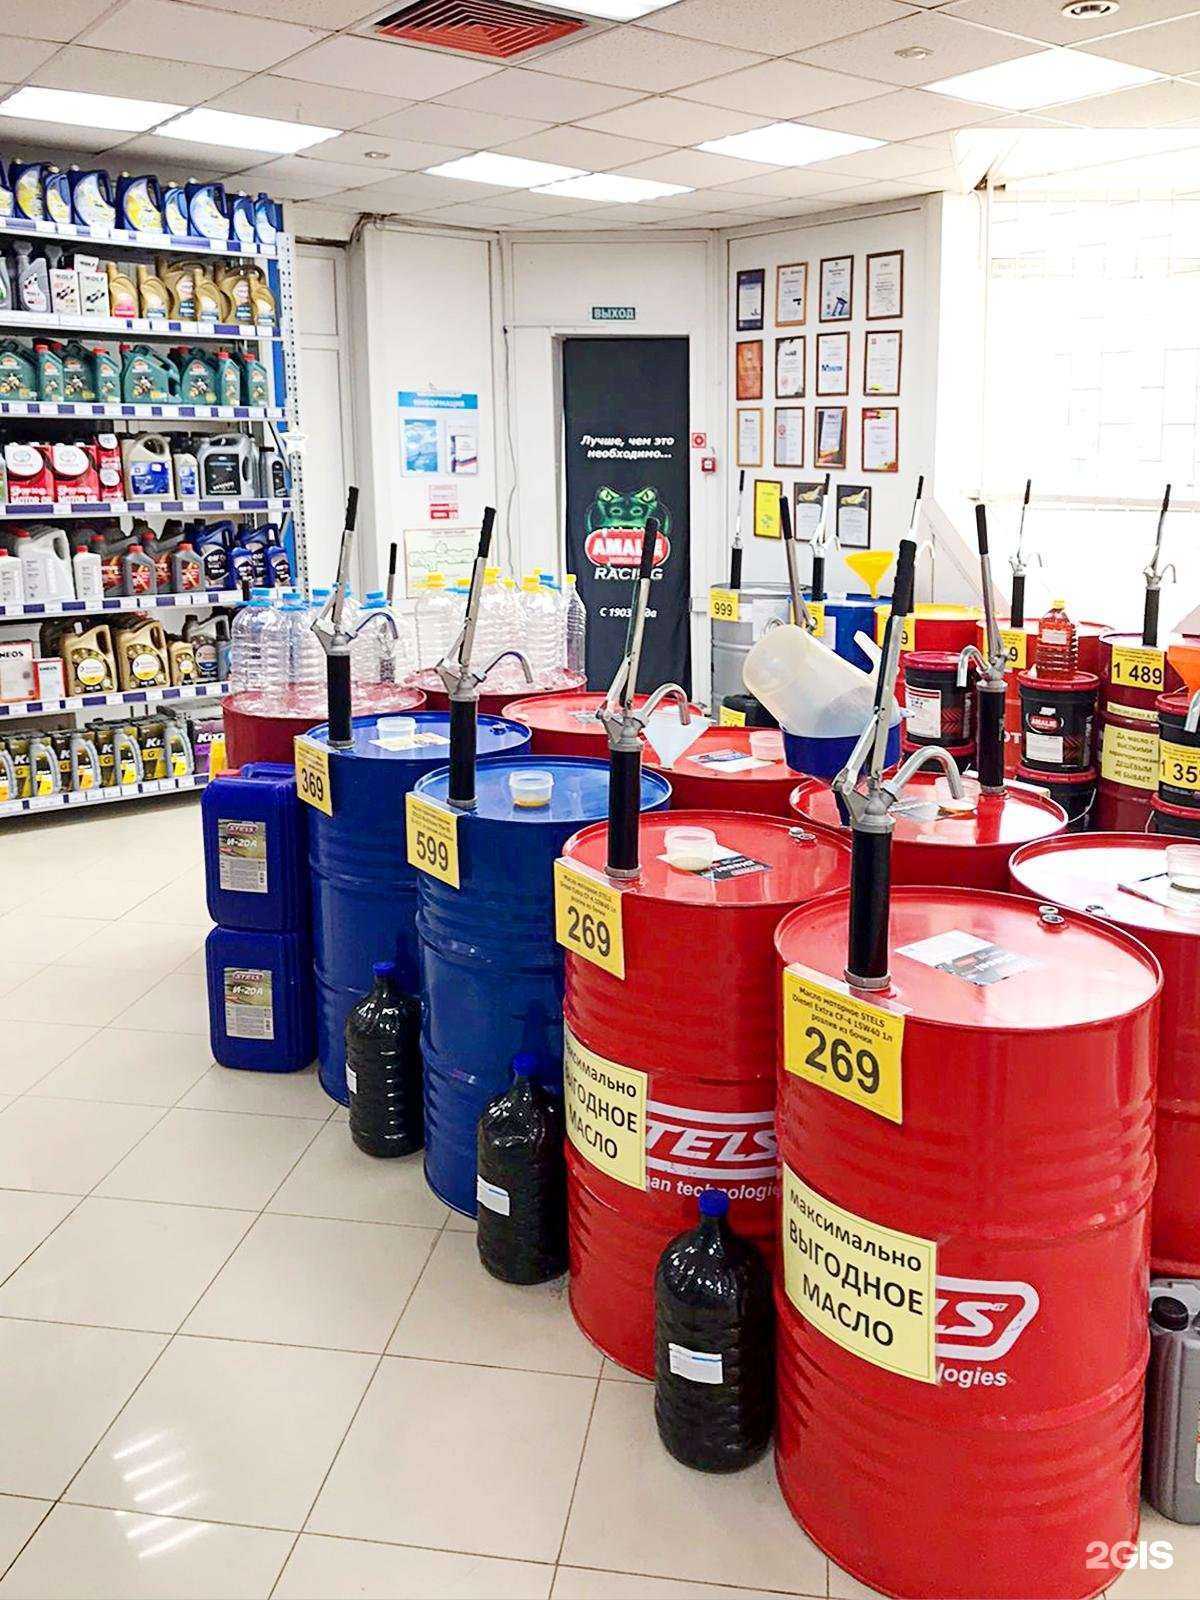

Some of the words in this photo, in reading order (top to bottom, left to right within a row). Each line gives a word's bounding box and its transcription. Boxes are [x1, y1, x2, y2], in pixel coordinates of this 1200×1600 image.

[593, 308, 635, 320] ВЫХОД
[580, 435, 625, 447] Лучше,
[628, 437, 651, 446] чем
[653, 437, 675, 446] это
[587, 448, 672, 460] необходимо...
[594, 567, 663, 580] RACIG
[608, 608, 633, 618] 1903
[714, 603, 733, 616] 999
[1128, 664, 1163, 685] 489
[301, 767, 324, 802] 369
[1173, 763, 1200, 784] 35
[416, 831, 449, 872] 599
[567, 905, 611, 957] 269
[799, 986, 822, 1002] Масло
[861, 1012, 886, 1029] STELS
[814, 1003, 834, 1018] Extra
[804, 1025, 881, 1096] 269
[569, 1103, 618, 1160] МАСЛО
[646, 1119, 777, 1162] TELS
[788, 1218, 924, 1316] ВЫГОДНОЕ
[803, 1273, 895, 1347] МАСЛО
